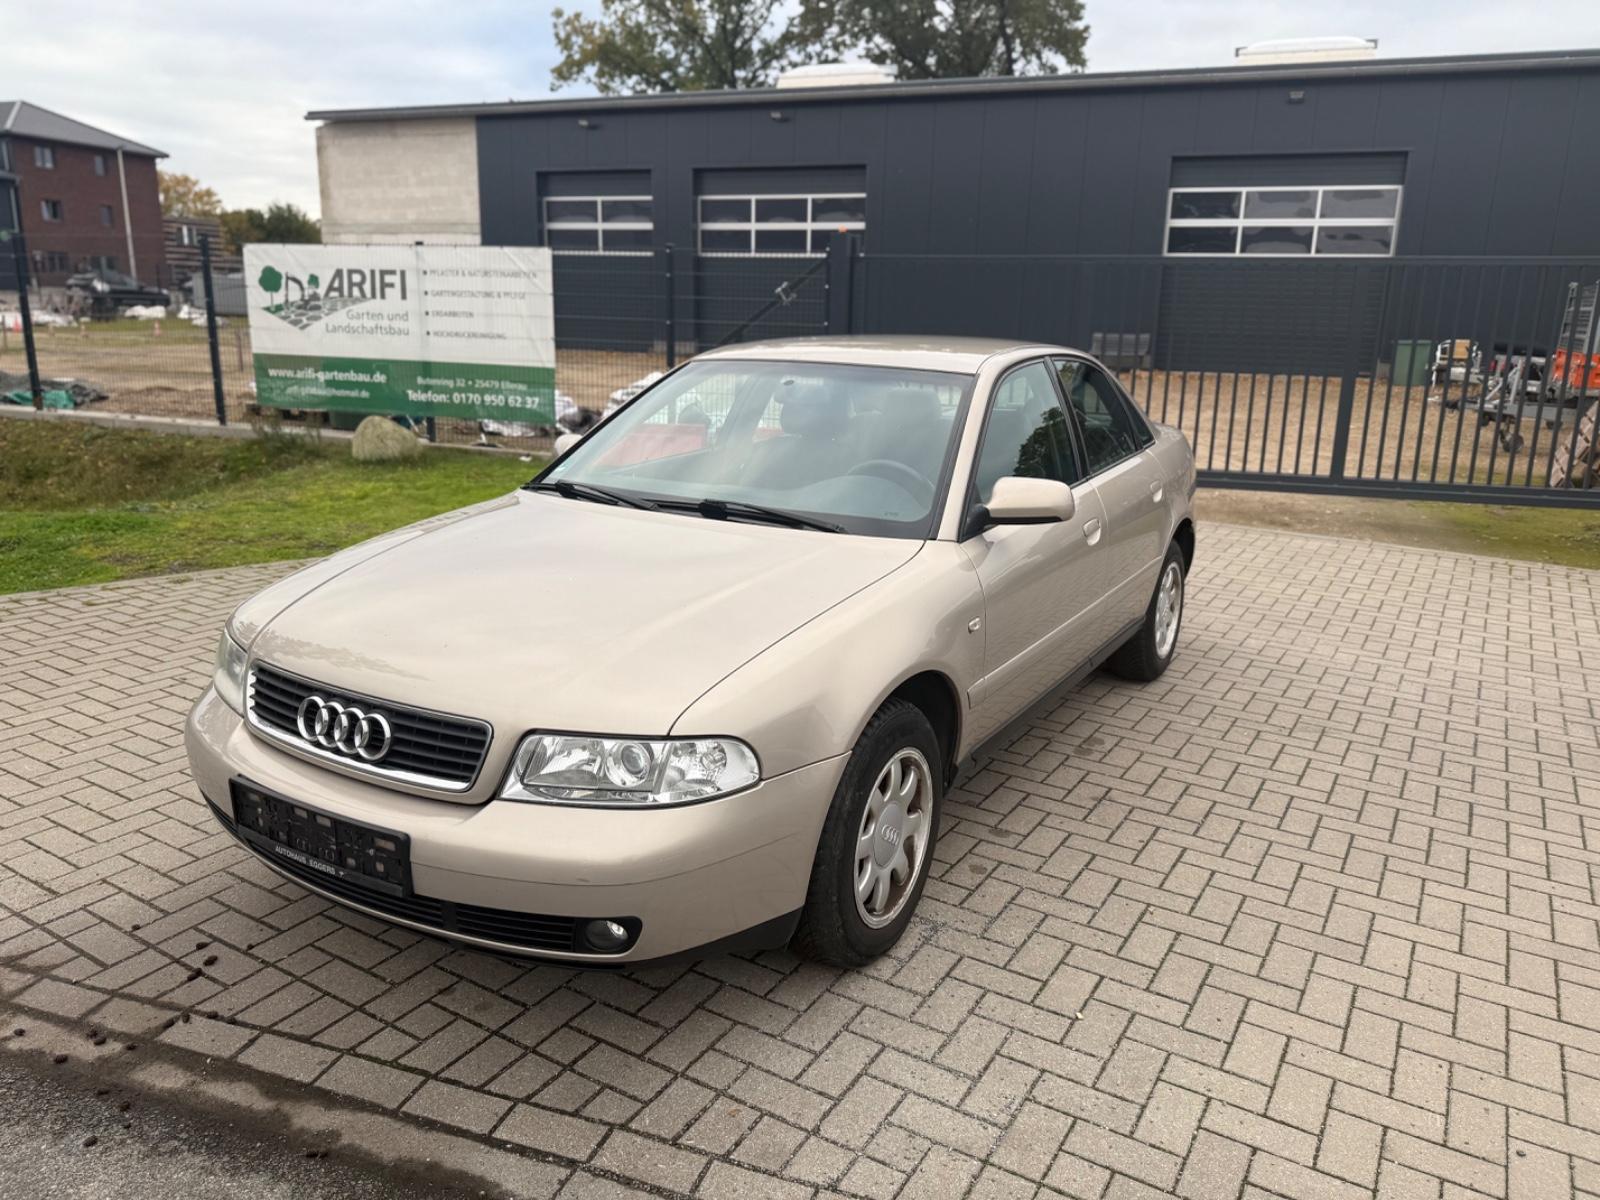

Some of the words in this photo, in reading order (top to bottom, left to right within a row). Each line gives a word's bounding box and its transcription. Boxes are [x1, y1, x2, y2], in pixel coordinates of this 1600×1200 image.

[323, 268, 407, 300] ARIFI
[346, 310, 383, 321] Garten
[387, 311, 409, 322] und
[325, 323, 410, 336] Landschaftsbau
[268, 367, 387, 383] www.arifi-gartenbau.de
[474, 379, 499, 389] 25479
[406, 390, 450, 403] Telefon:
[453, 392, 482, 405] 0170
[483, 394, 505, 406] 950
[507, 396, 522, 408] 62
[525, 397, 540, 409] 37
